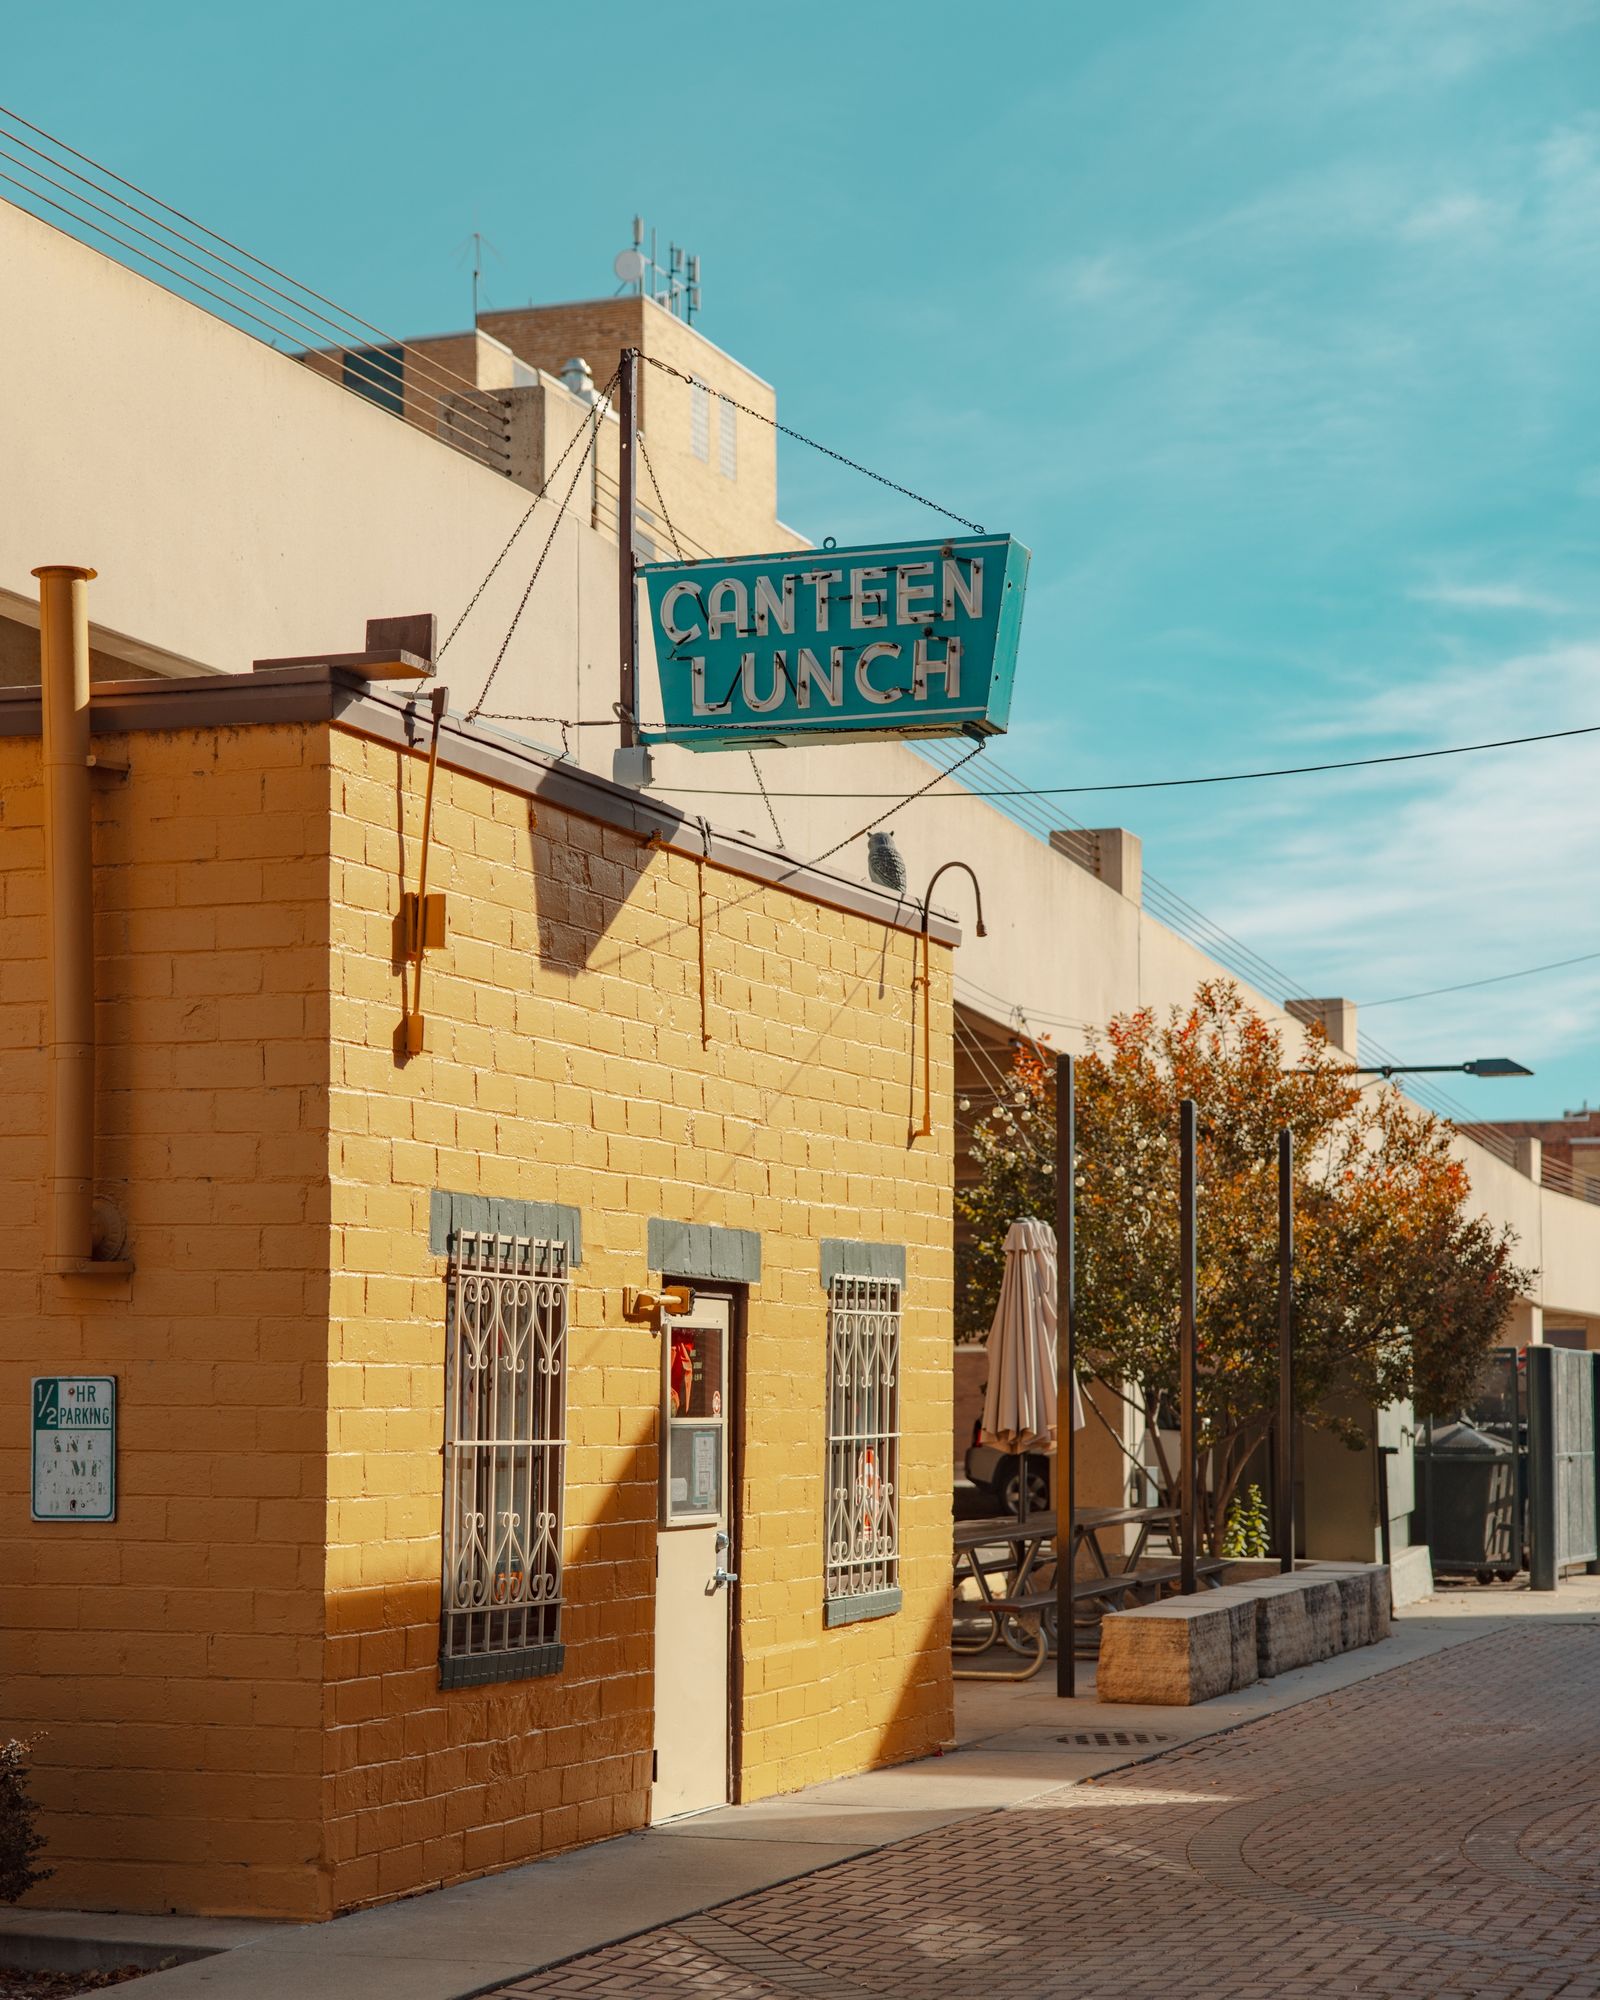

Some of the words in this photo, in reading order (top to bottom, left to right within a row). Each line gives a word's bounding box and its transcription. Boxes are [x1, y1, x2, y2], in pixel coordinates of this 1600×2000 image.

[660, 557, 985, 643] CANTEEN
[691, 636, 961, 716] LUNCH
[59, 1407, 109, 1425] PARKING
[76, 1385, 96, 1402] HR
